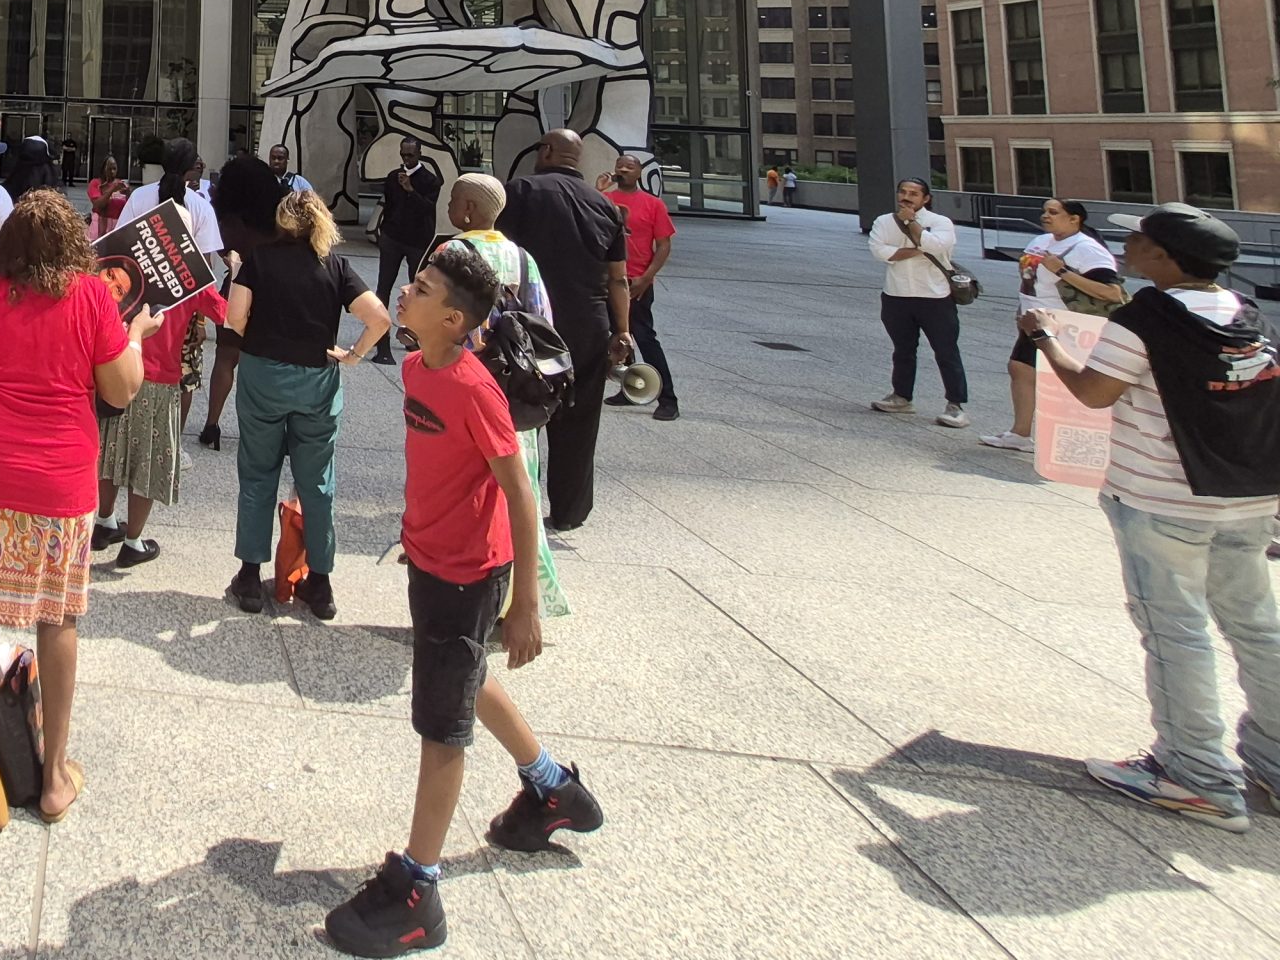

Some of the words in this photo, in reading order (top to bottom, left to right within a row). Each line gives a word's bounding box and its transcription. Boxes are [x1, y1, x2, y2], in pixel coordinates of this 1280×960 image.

[136, 220, 165, 263] FROM
[157, 262, 184, 299] DEED
[149, 214, 196, 289] EMANATED
